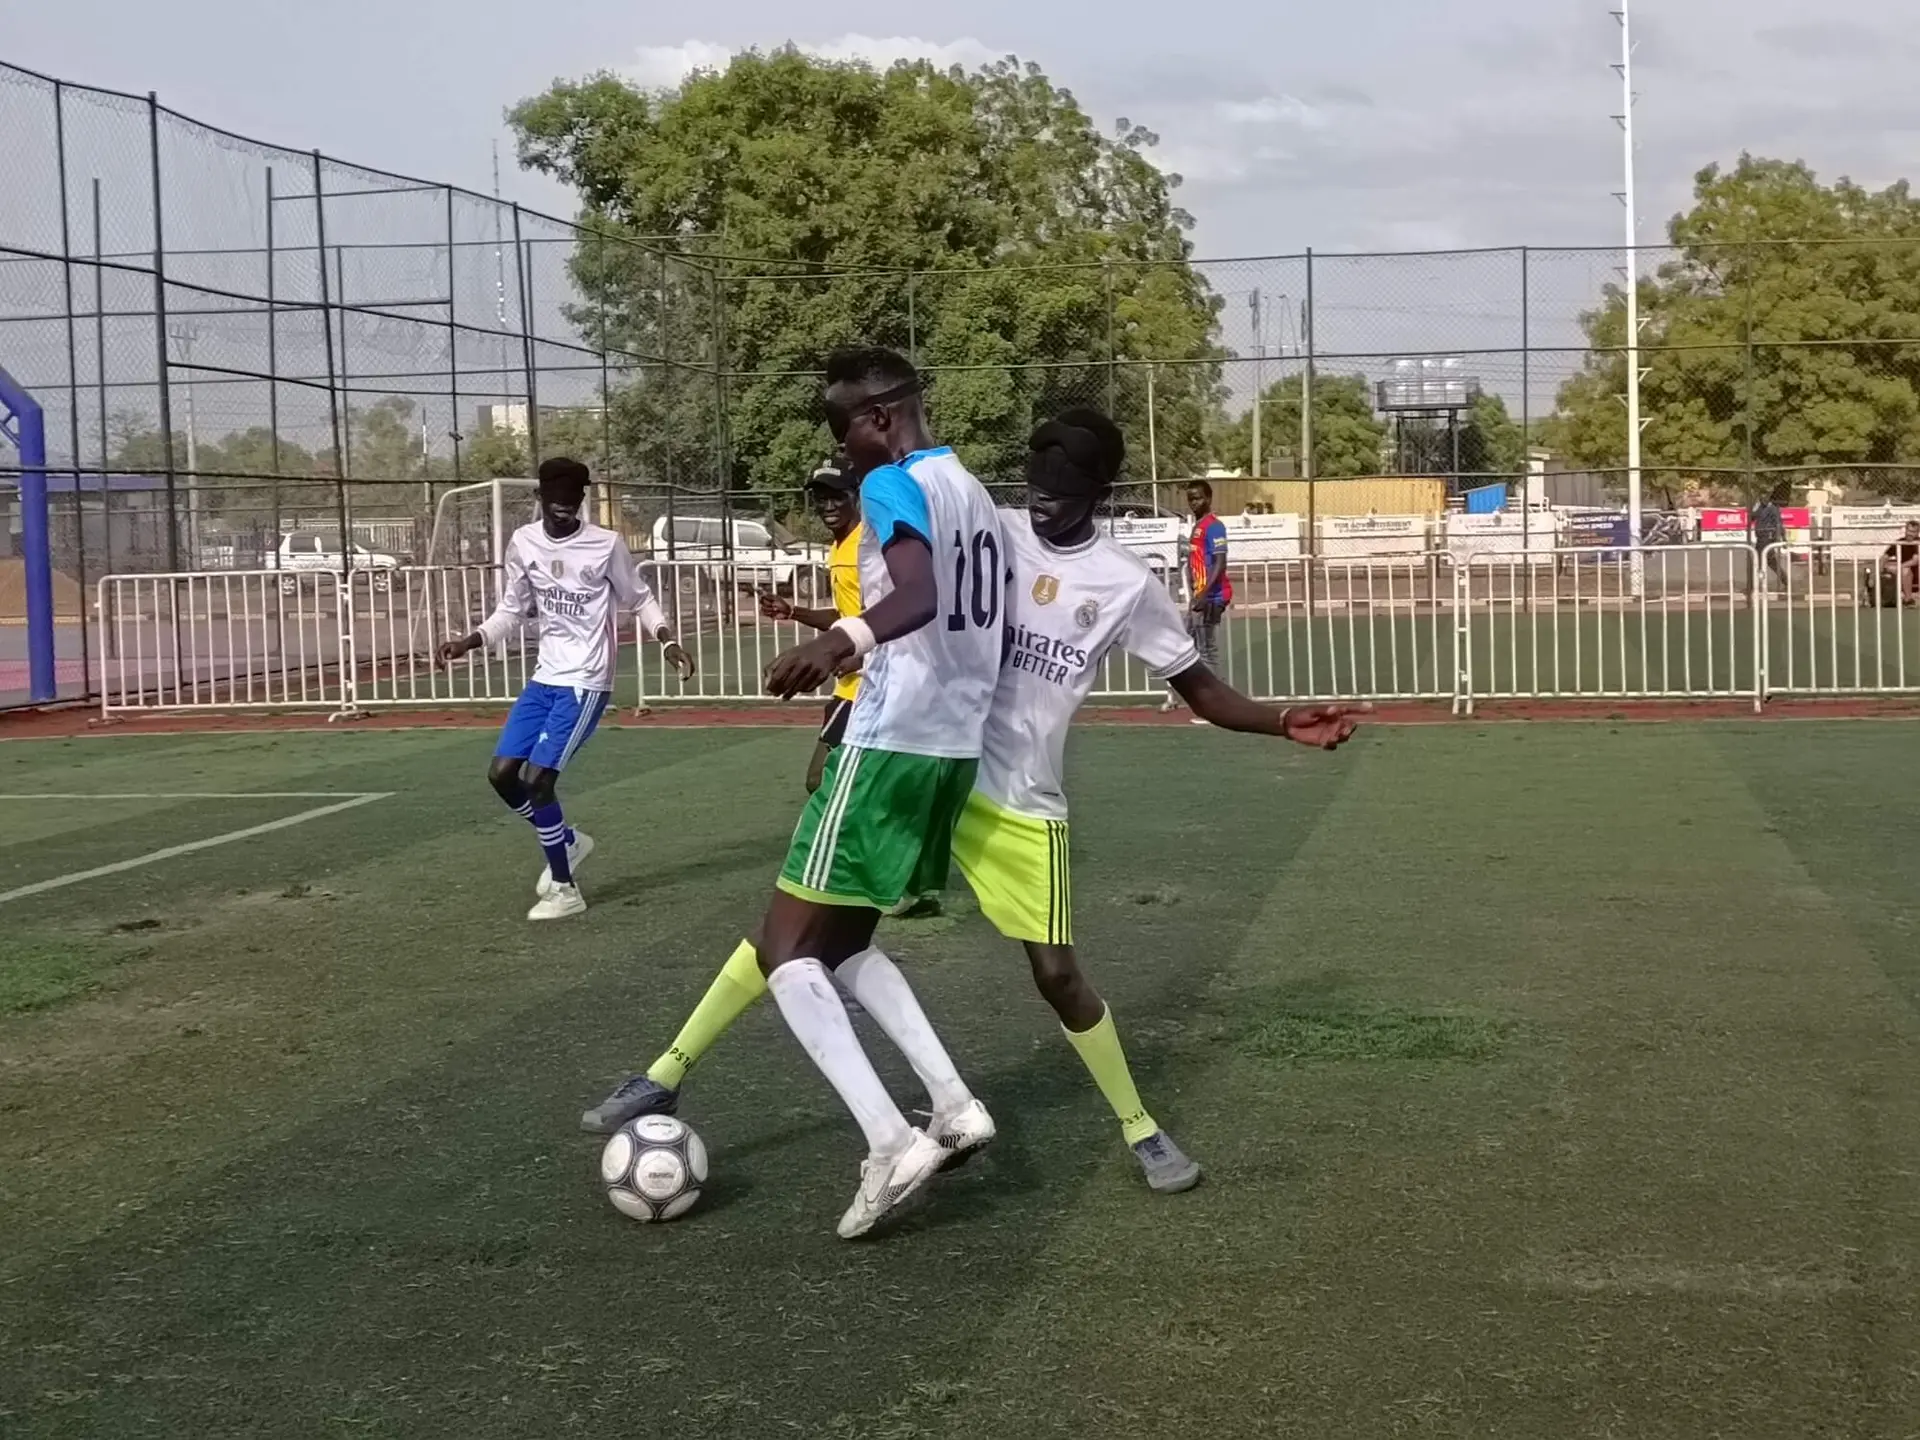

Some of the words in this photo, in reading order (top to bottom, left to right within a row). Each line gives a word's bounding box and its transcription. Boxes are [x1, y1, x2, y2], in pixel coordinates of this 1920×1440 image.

[947, 528, 999, 632] 10
[1006, 623, 1089, 668] irates
[1012, 649, 1069, 686] BETTER
